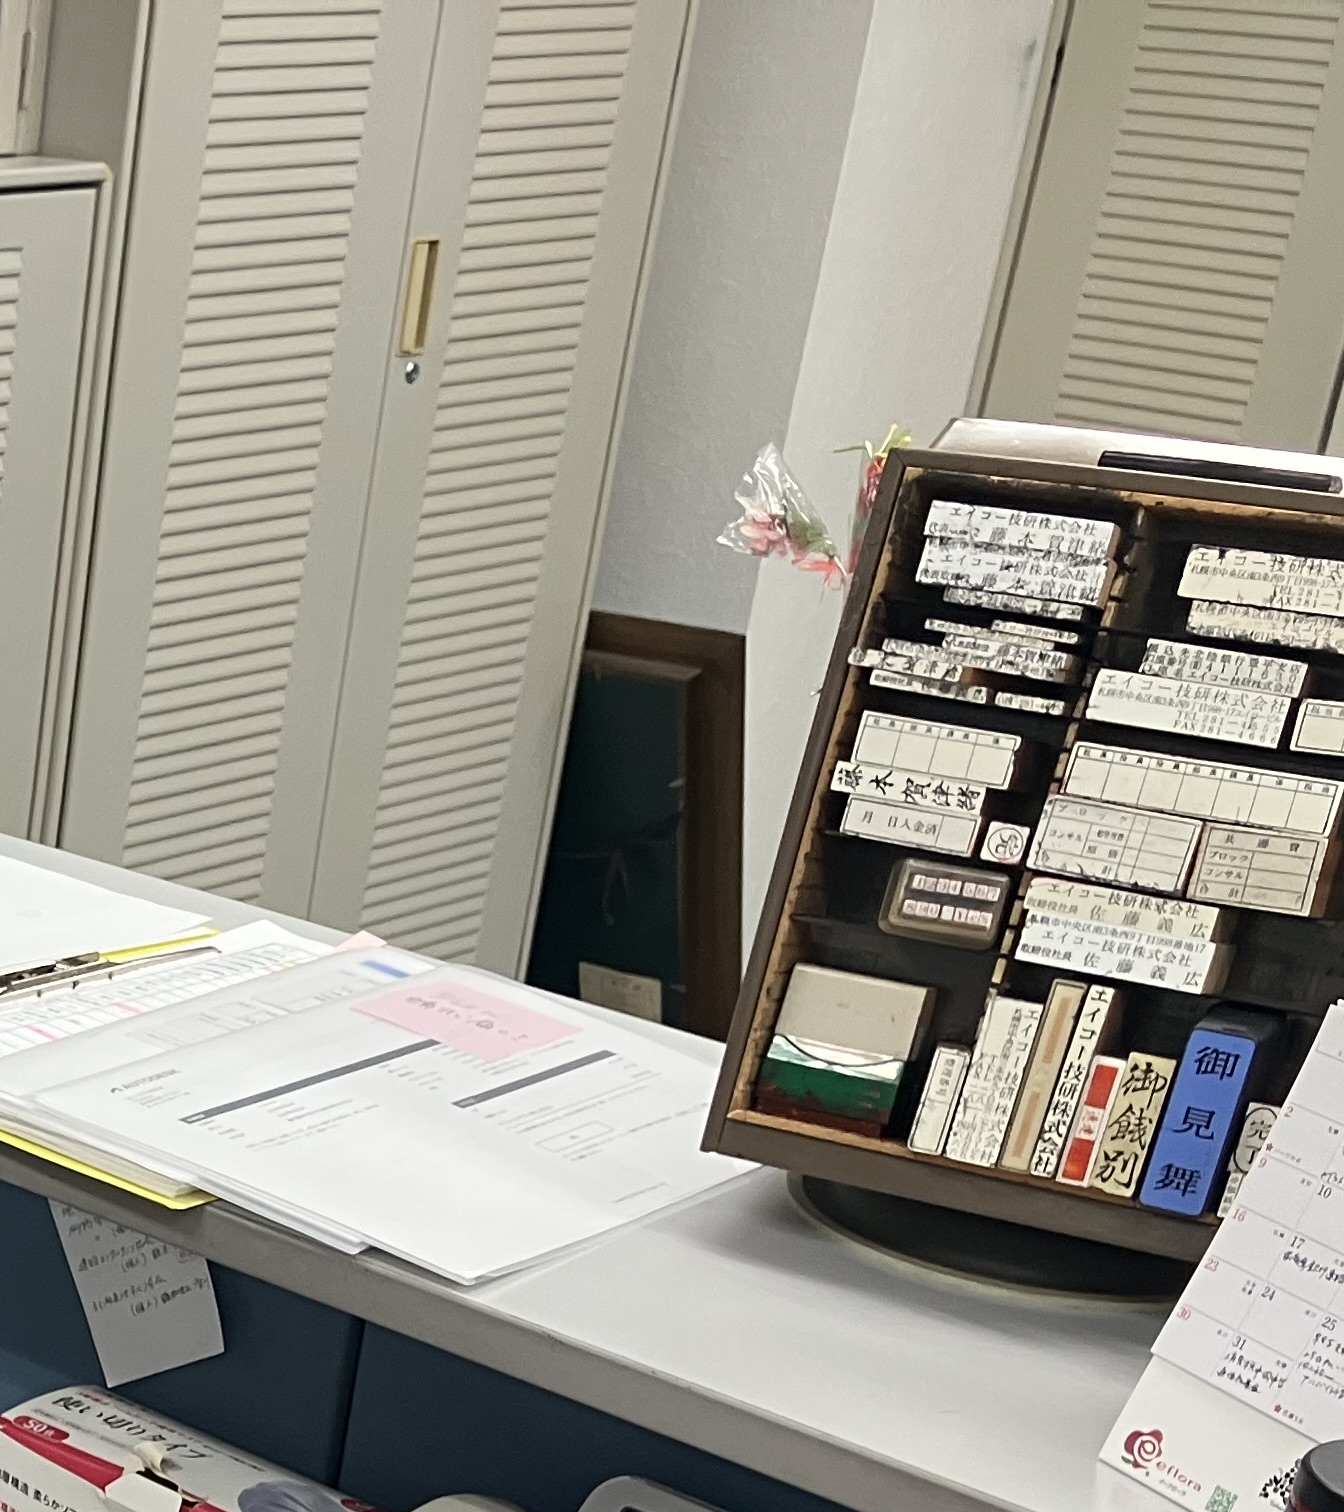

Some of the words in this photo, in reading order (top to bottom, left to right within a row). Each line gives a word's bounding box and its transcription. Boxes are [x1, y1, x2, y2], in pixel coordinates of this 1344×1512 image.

[950, 505, 1096, 537] エイコー技研株式会社
[1101, 673, 1285, 714] エイコー技研株式会社
[1177, 710, 1200, 721] TEL
[862, 811, 874, 824] 月
[1208, 850, 1250, 863] ブロック
[1206, 866, 1243, 881] コンサル
[1047, 883, 1200, 919] エイコー技研株式会社
[1041, 930, 1192, 967] エイコー技研株式会社
[1084, 951, 1203, 987] 佐藤義広
[980, 1009, 1039, 1163] エイコー技研株式会社
[1033, 988, 1109, 1172] エイコー技研株式会社
[1283, 1105, 1294, 1118] 2
[1096, 1061, 1168, 1189] 御餞別
[1153, 1045, 1241, 1198] 御見舞
[1258, 1157, 1268, 1169] 9
[1316, 1183, 1333, 1200] 10
[1232, 1208, 1247, 1223] 16
[1290, 1235, 1306, 1251] 17
[1203, 1257, 1220, 1273] 23
[1260, 1286, 1277, 1301] 24
[1321, 1316, 1338, 1332] 25
[1231, 1335, 1248, 1351] 31
[52, 1395, 213, 1460] 使い切りタイプ
[1156, 1460, 1202, 1493] eflora
